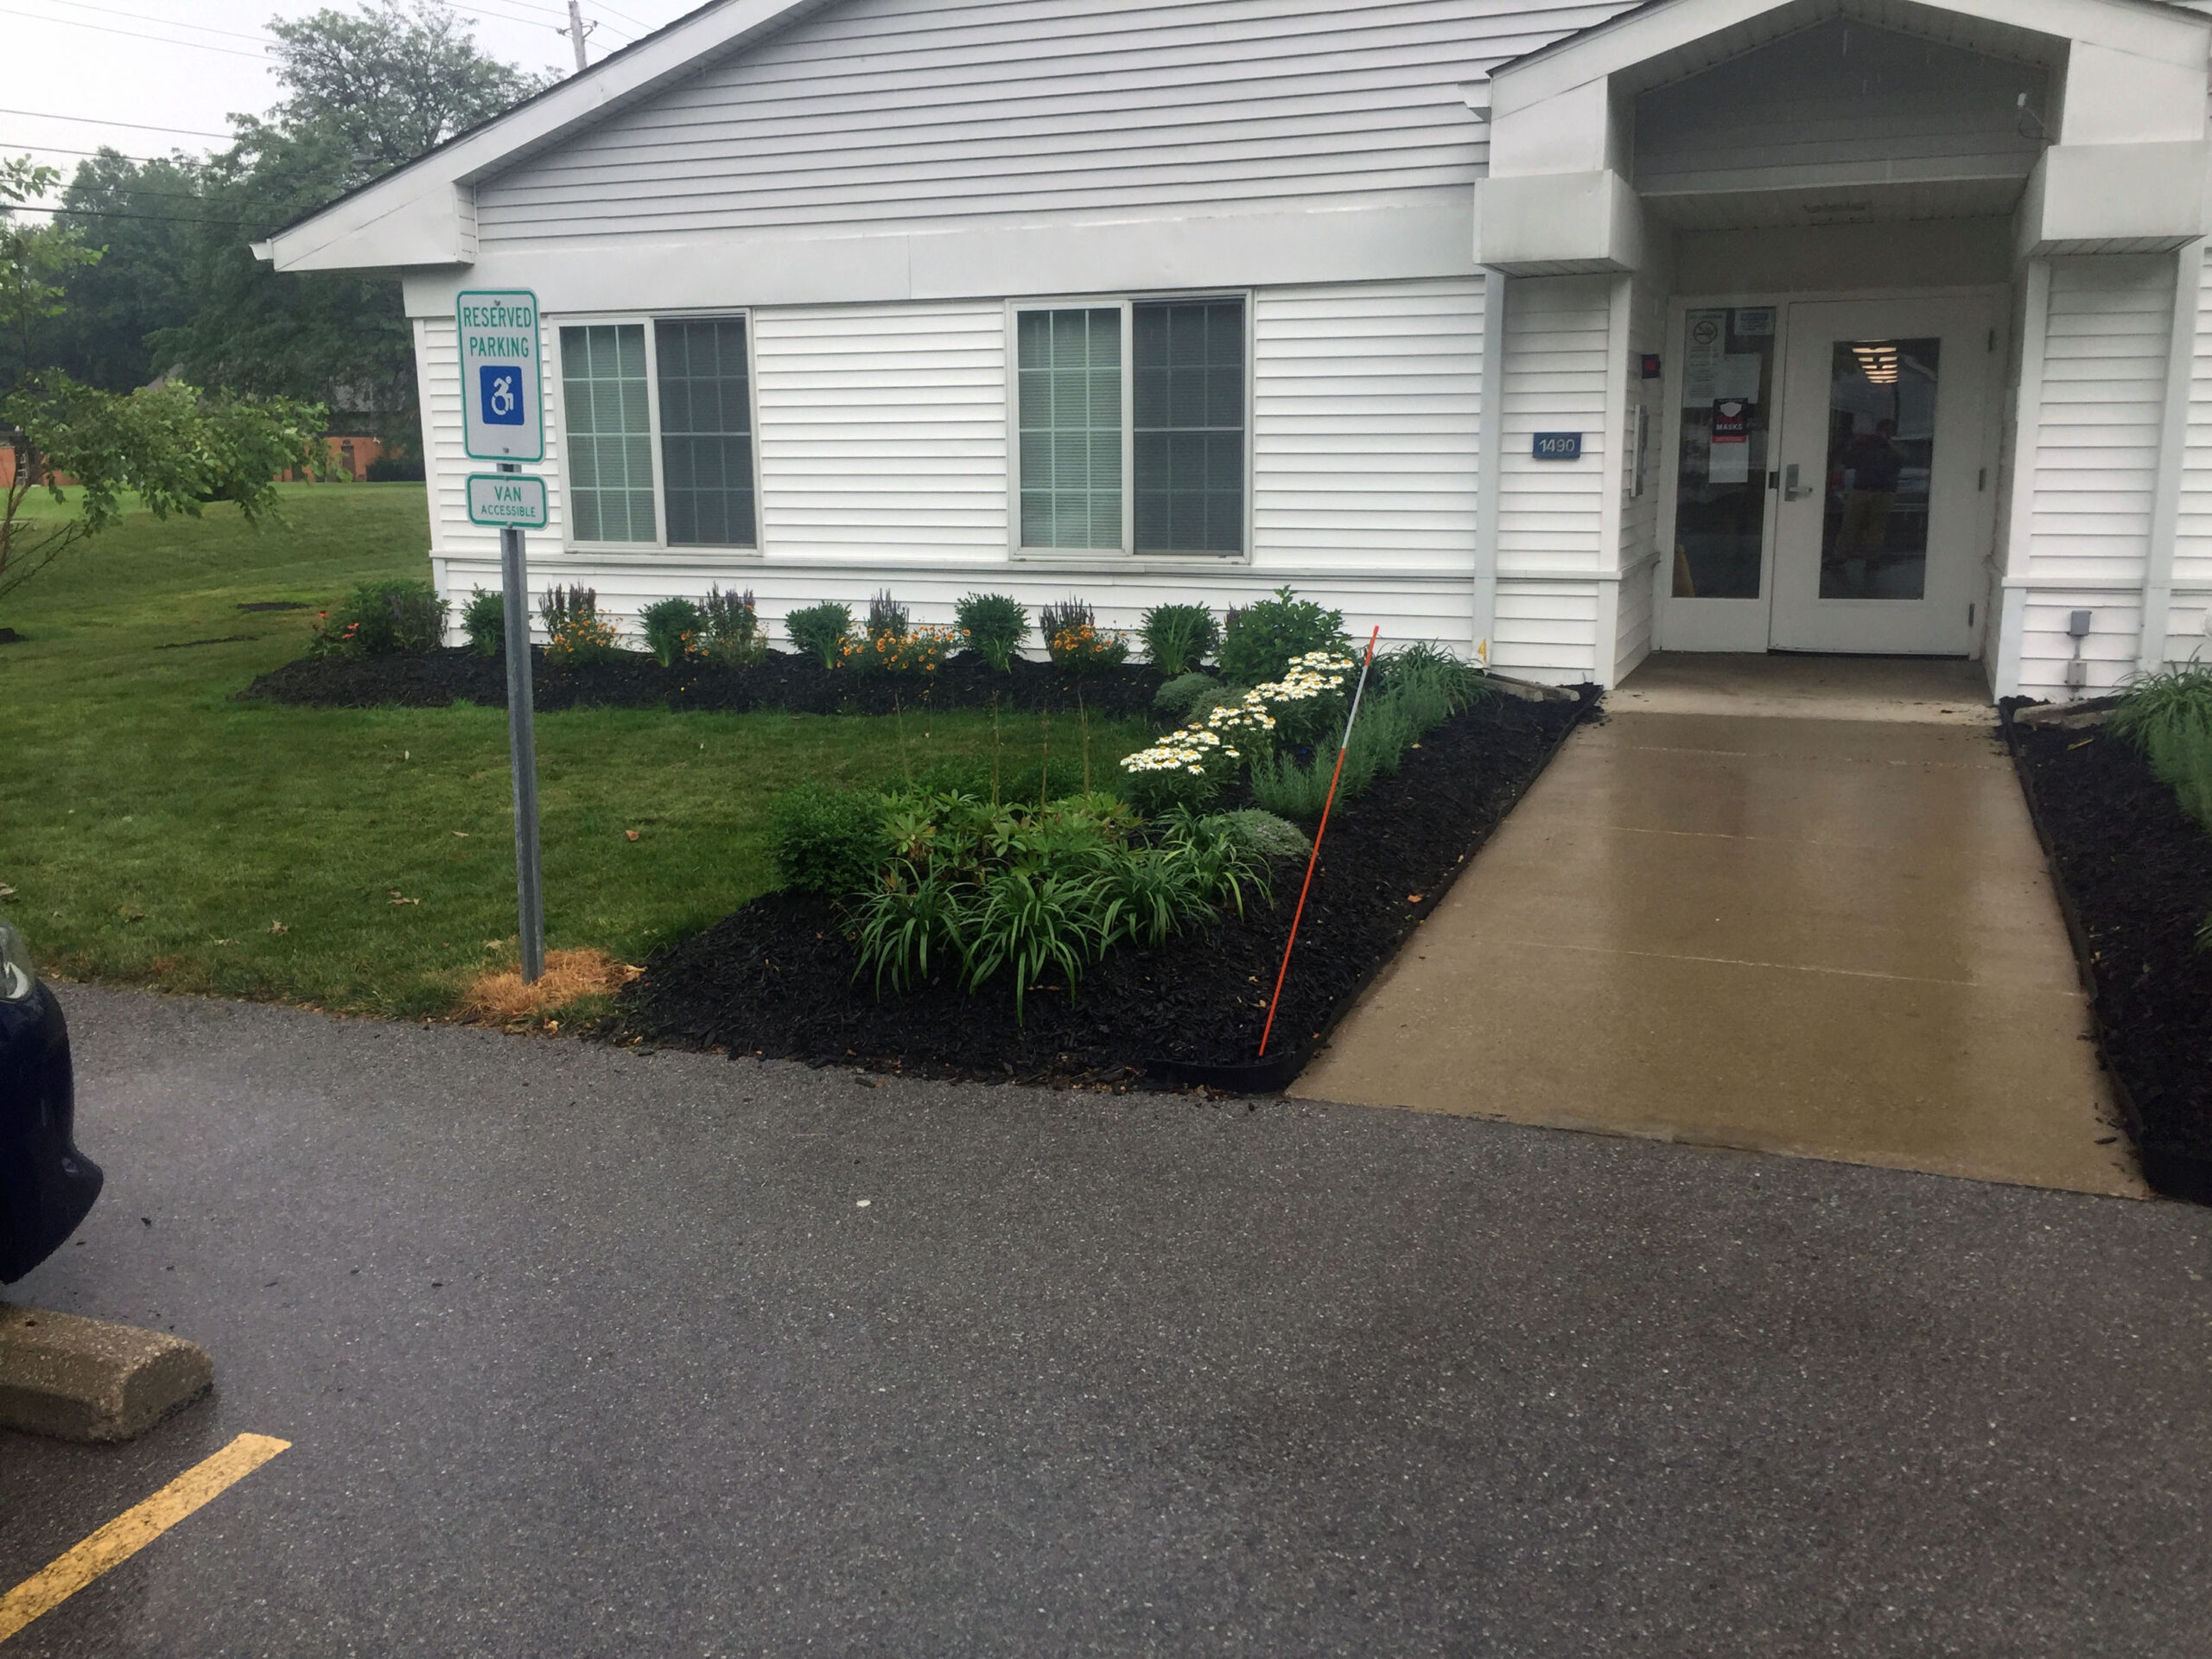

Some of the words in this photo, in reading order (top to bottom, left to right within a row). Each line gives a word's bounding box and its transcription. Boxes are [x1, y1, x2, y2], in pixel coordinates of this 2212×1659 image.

[463, 307, 531, 327] RESERVED
[469, 336, 529, 358] PARKING
[1539, 438, 1575, 452] 1490
[494, 486, 522, 502] VAN
[480, 505, 536, 518] ACCESSIBLE
